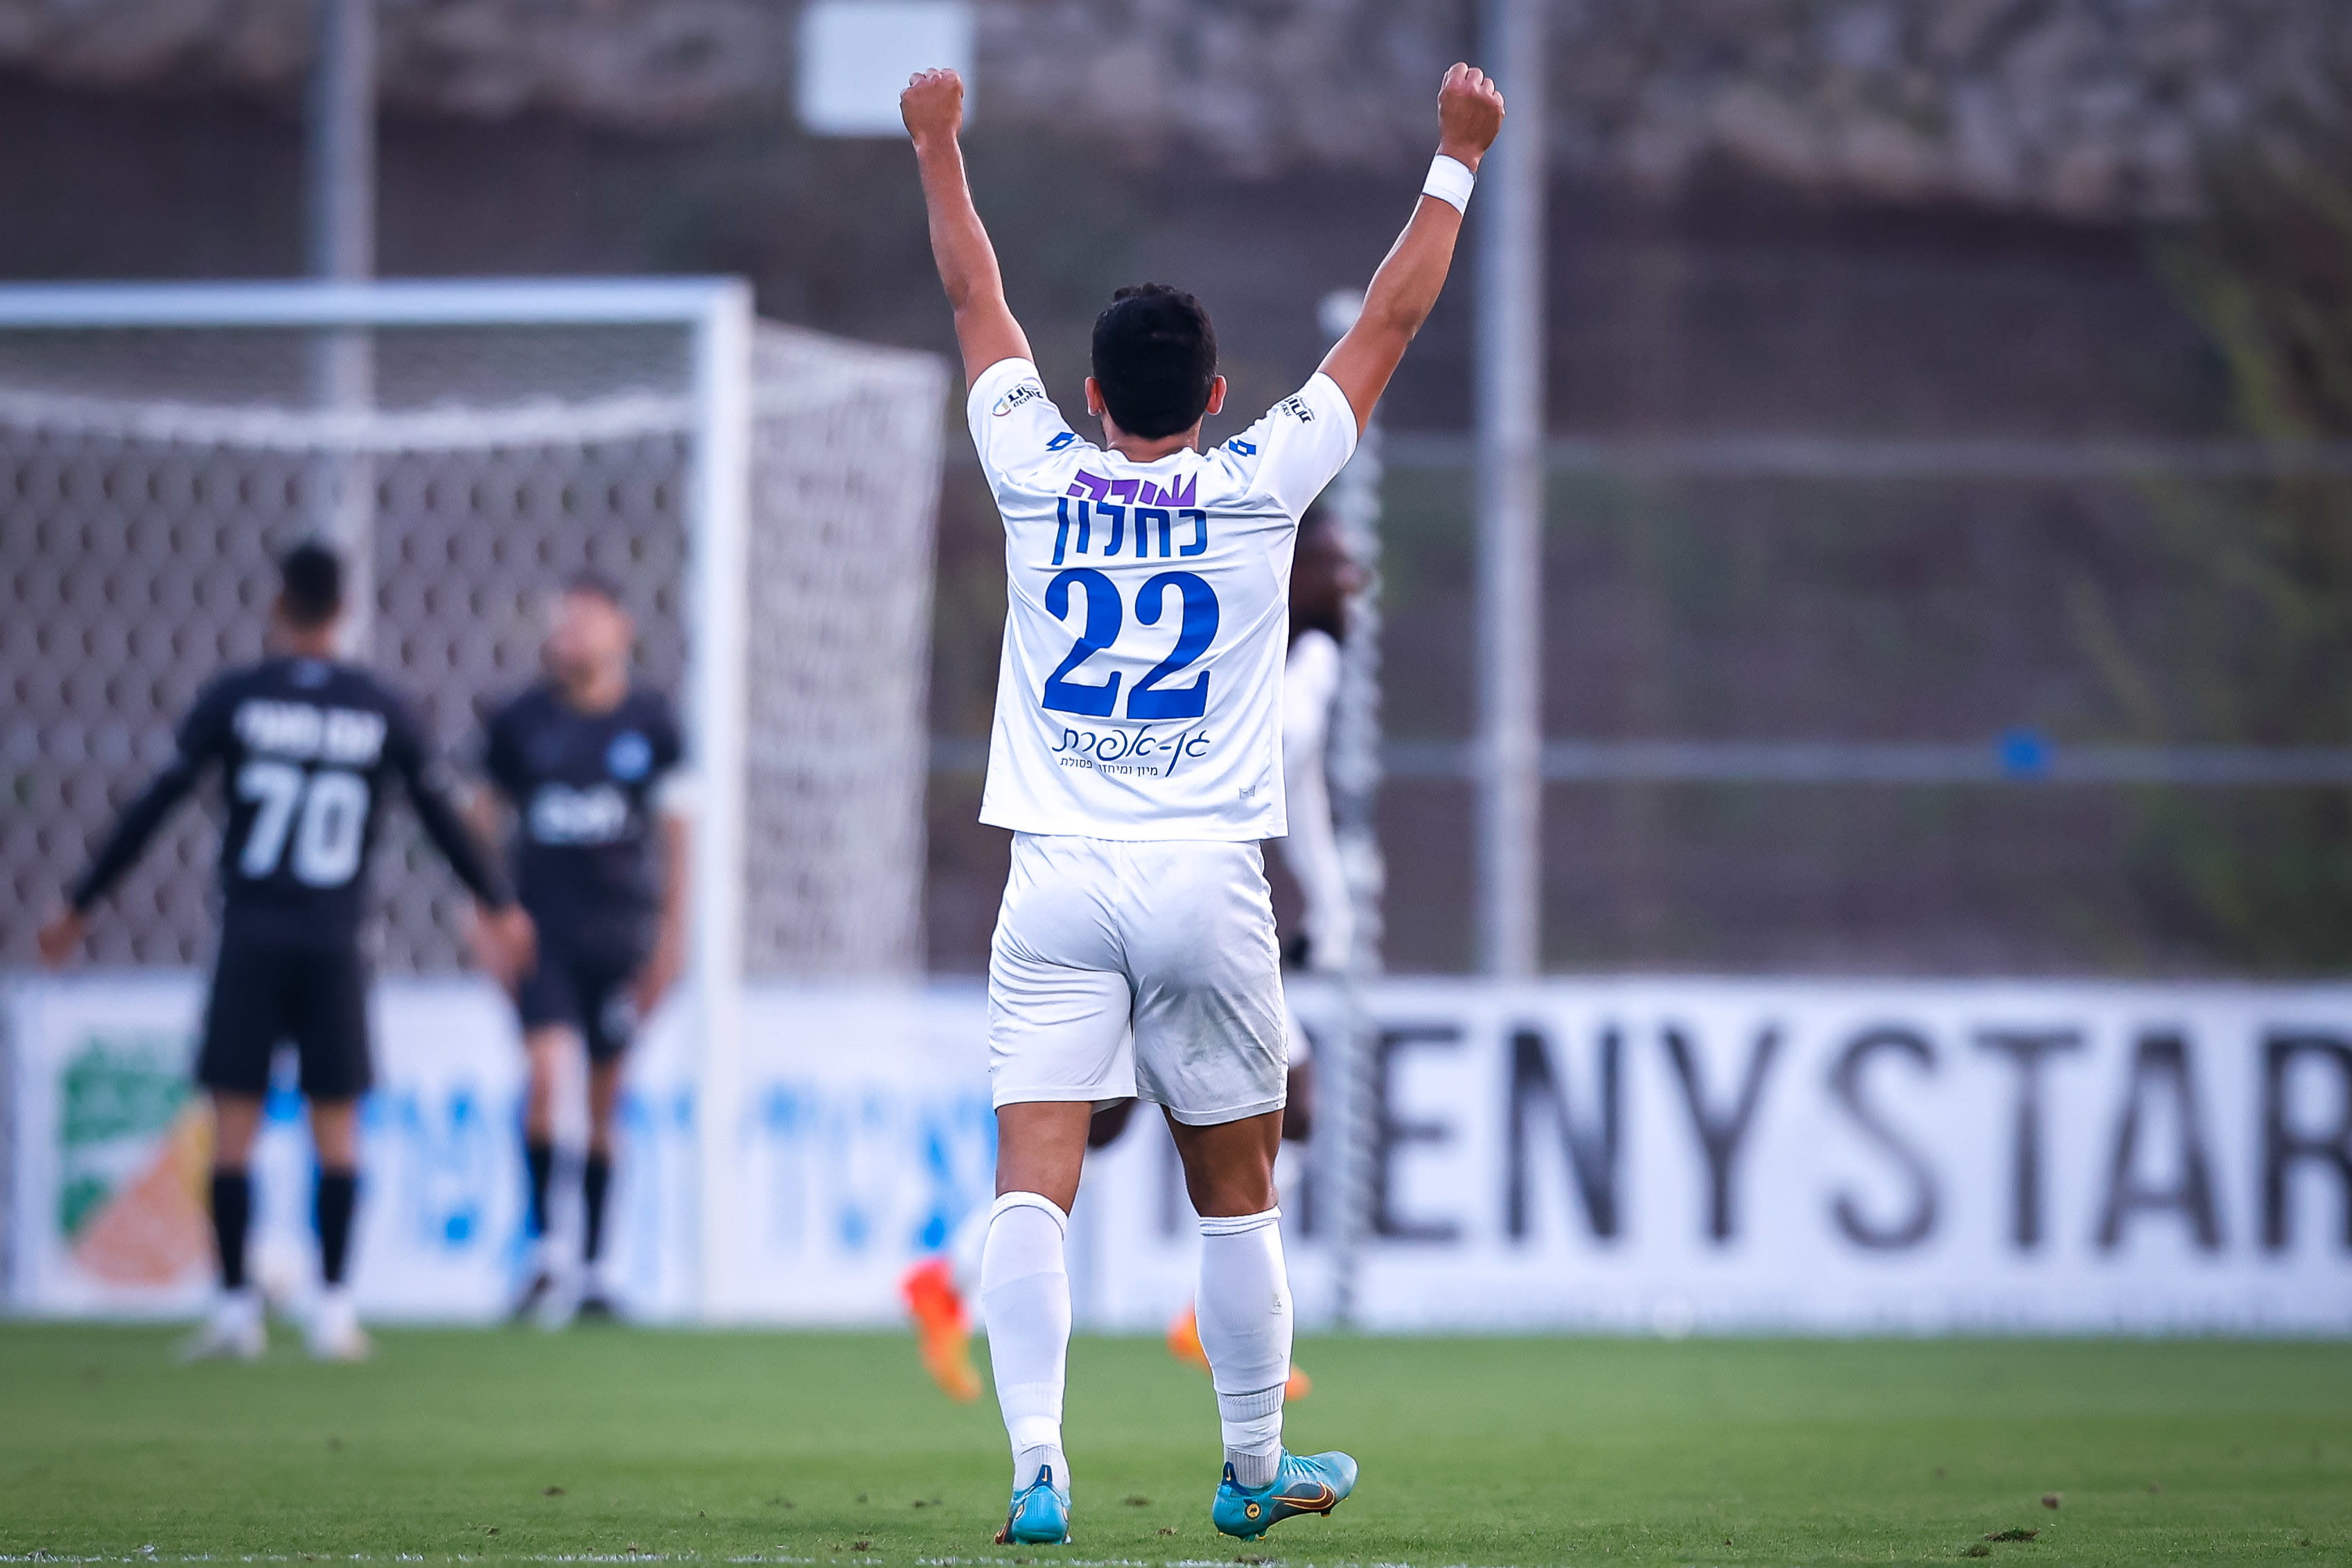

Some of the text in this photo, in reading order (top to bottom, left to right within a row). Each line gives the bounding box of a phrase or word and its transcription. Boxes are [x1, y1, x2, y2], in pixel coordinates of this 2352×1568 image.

[1051, 496, 1208, 565] כחלון
[1042, 567, 1220, 720] 22
[1060, 757, 1159, 777] מיון ומיחזו פסולת
[234, 762, 370, 887] 70
